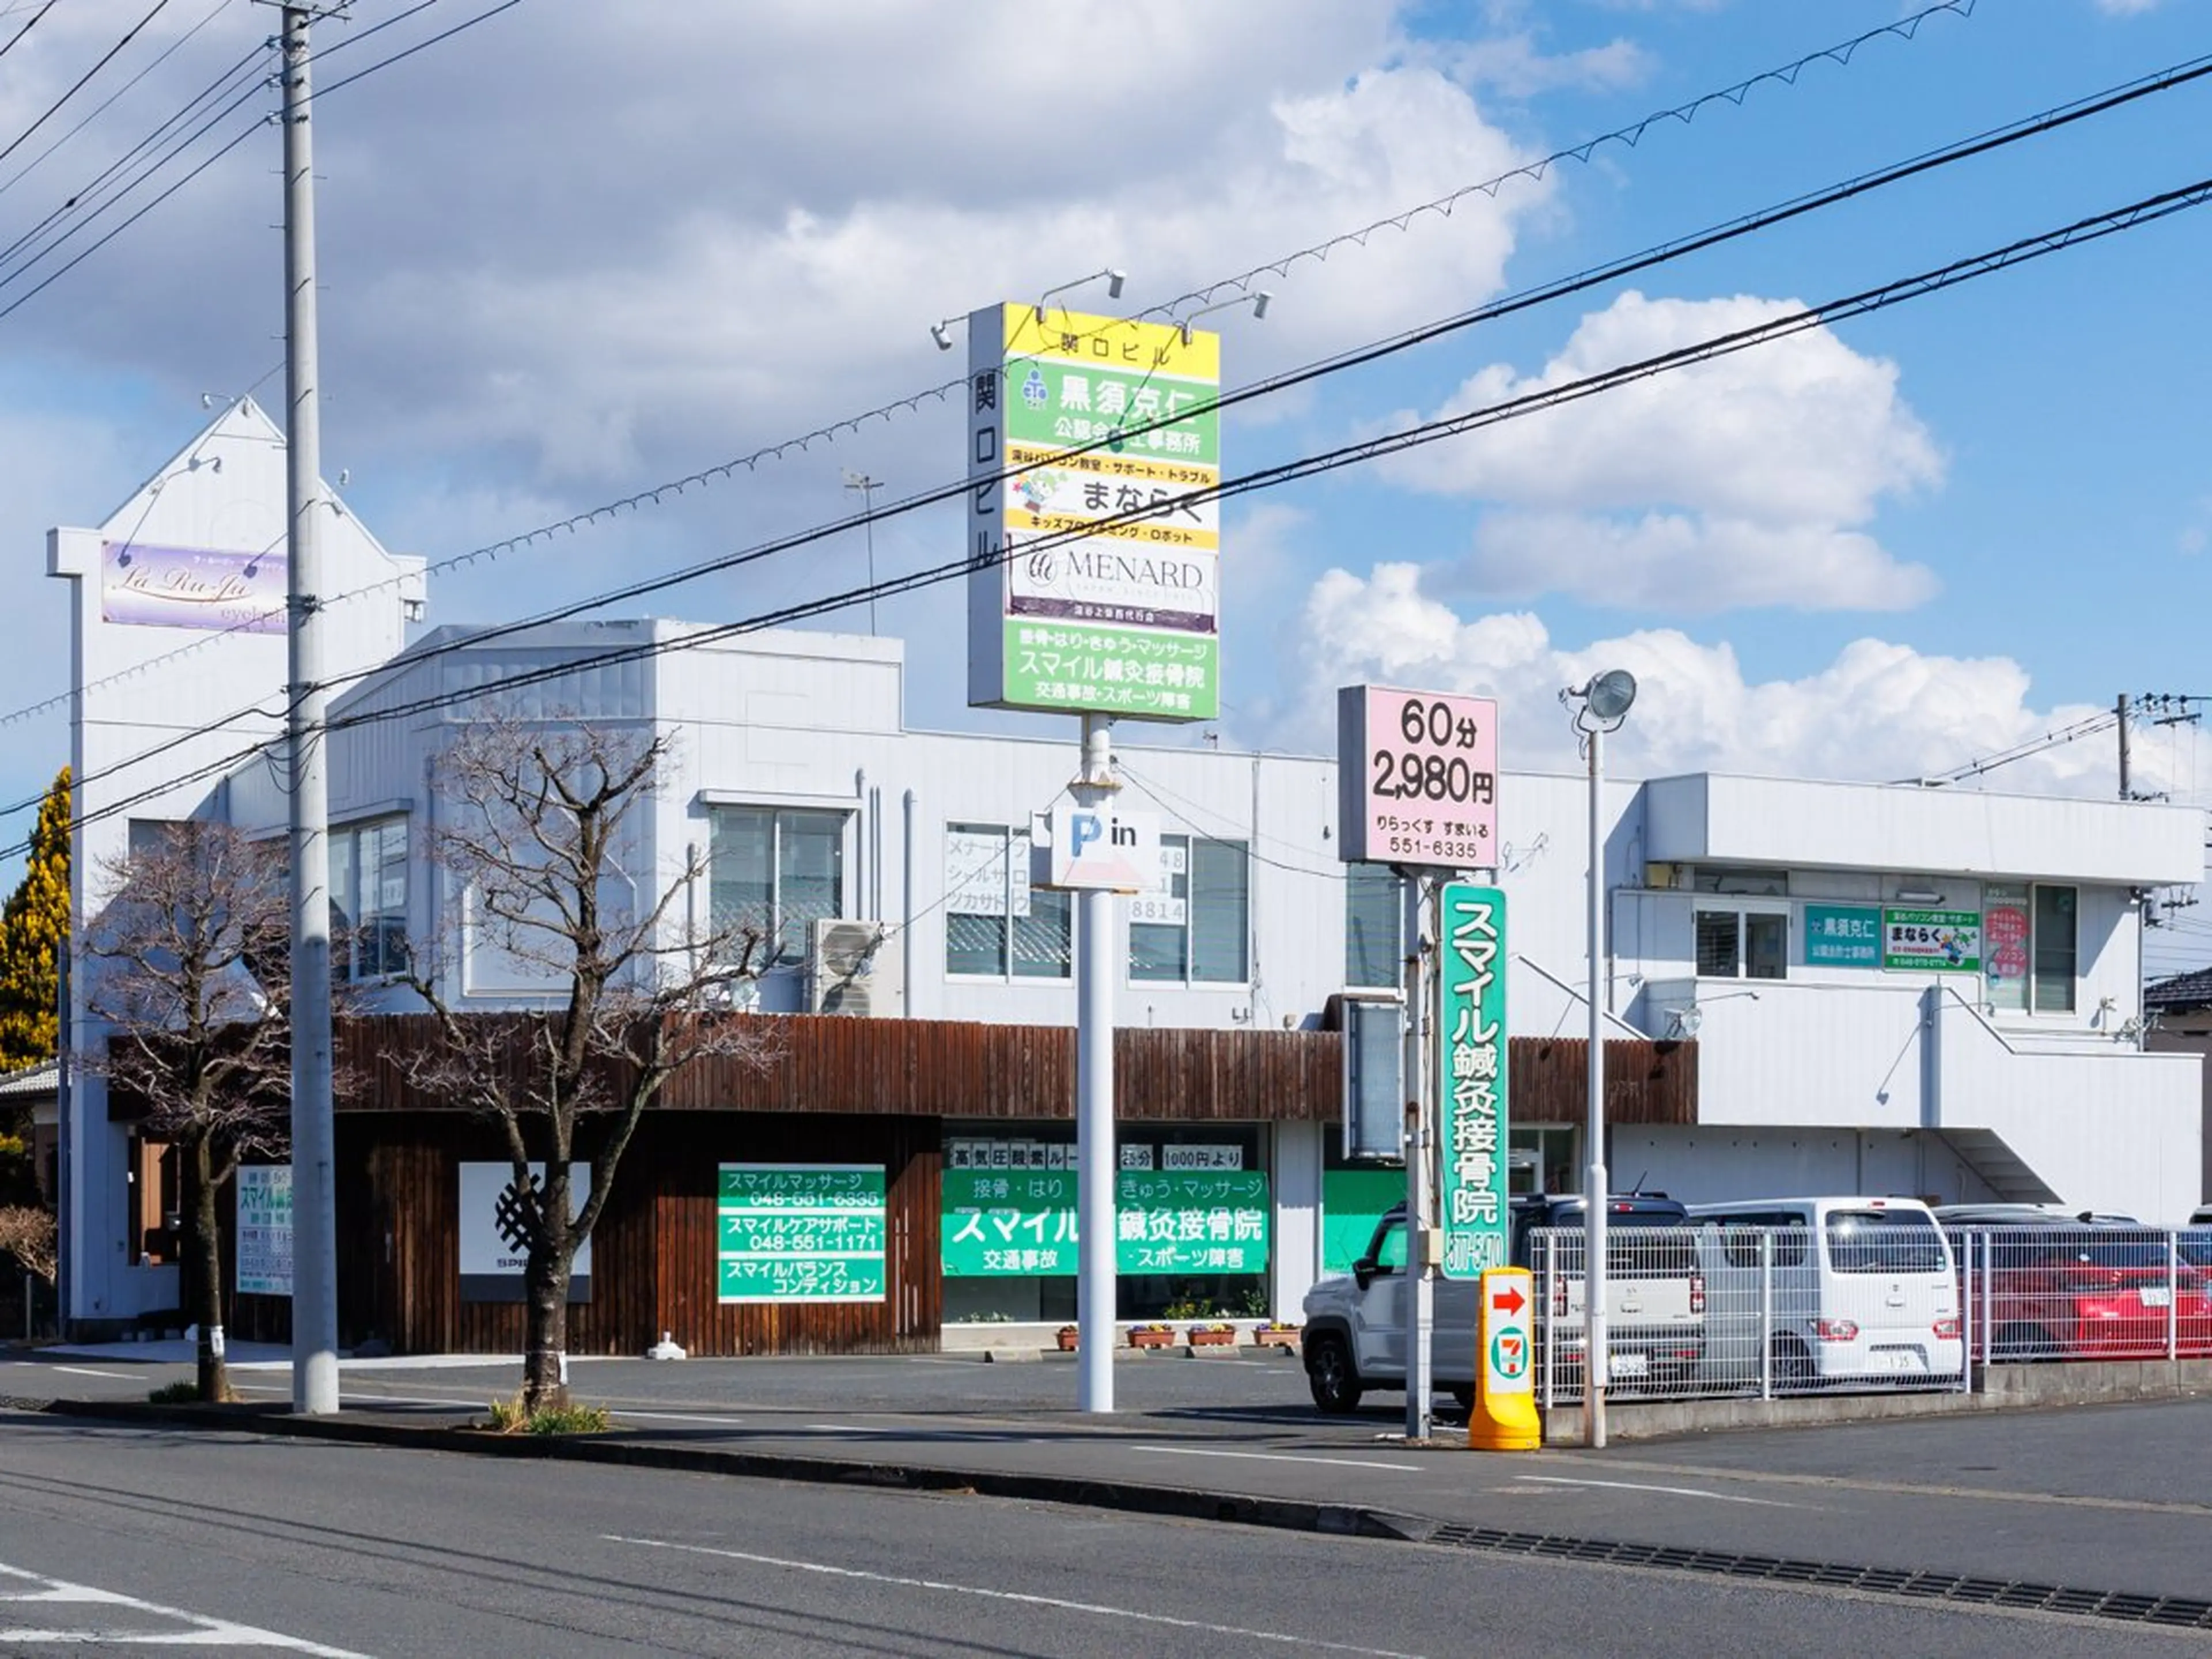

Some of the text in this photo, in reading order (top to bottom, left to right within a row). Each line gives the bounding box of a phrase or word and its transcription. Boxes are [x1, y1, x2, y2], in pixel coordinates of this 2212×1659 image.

[1061, 332, 1170, 365] 関口ビル
[1060, 375, 1196, 423] 黒須克仁
[1054, 416, 1201, 455] 公認会士事務所
[1066, 551, 1203, 589] MENARD
[1018, 651, 1206, 689] スマイル鍼灸接骨院
[1035, 681, 1192, 710] 交通事故・スポーツ障害
[1400, 698, 1477, 749] 60分
[1373, 749, 1494, 805] 2,980円
[1111, 817, 1137, 846] in
[1377, 815, 1434, 834] りらっくす
[1389, 837, 1477, 859] 551-6335
[1132, 902, 1184, 920] 8814
[1892, 926, 1941, 943] まならく
[1452, 903, 1499, 1225] スマイル鍼灸接骨院
[1165, 1152, 1240, 1166] 1000円より
[728, 1173, 863, 1190] スマイルマッサージ
[974, 1178, 1263, 1199] 接骨・はり きゅう・マッサージ
[749, 1191, 879, 1207] 048-551-6335
[727, 1217, 877, 1234] スマイルケアサポート
[952, 1206, 1263, 1243] スマイル 鍼灸接骨院
[750, 1234, 877, 1250] 048-551-1171
[727, 1262, 848, 1279] スマイルバランス
[983, 1249, 1058, 1271] 交通事故
[773, 1279, 877, 1294] コンディション
